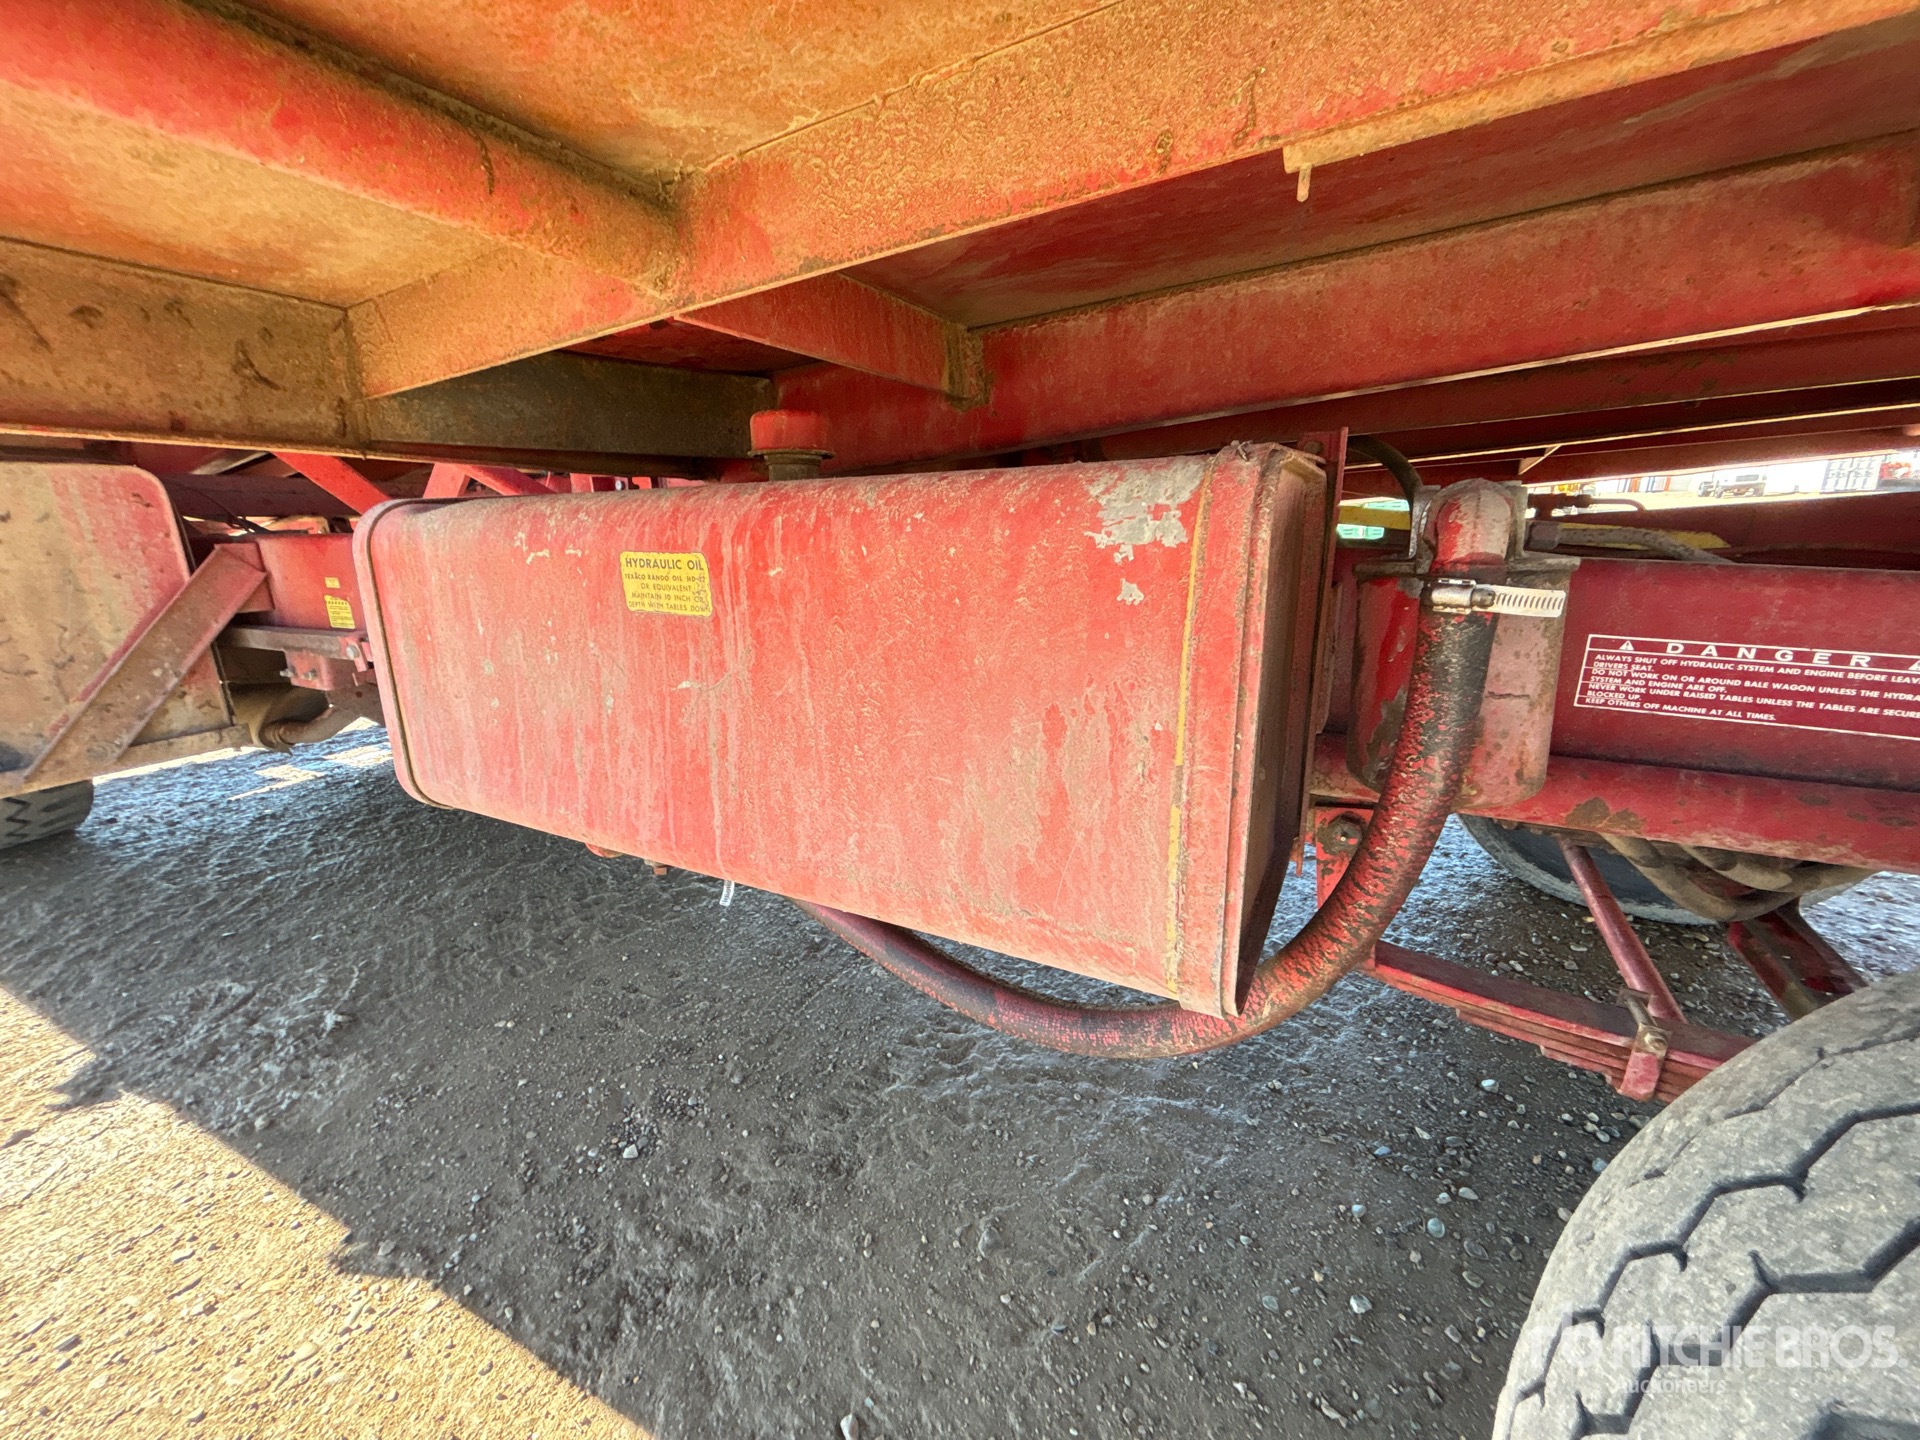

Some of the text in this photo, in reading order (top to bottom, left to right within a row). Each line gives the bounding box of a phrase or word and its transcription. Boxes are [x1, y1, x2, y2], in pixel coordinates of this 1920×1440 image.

[625, 558, 704, 571] HYDRAULIC OIL
[632, 592, 662, 600] MAINTAIN
[674, 594, 690, 602] INCH
[666, 603, 687, 611] TABLES
[1666, 643, 1871, 668] DANGER
[1595, 654, 1631, 662] ALWAYS
[1680, 660, 1734, 670] HYDRAULIC
[1737, 663, 1774, 674] SYSTEM
[1777, 667, 1801, 675] AND
[1804, 669, 1844, 678] ENGINE
[1847, 673, 1888, 682] BEFORE
[1590, 676, 1622, 684] SYSTEM
[1649, 681, 1683, 689] ENGINE
[1631, 672, 1659, 680] WORK
[1697, 677, 1741, 686] AROUND
[1772, 683, 1815, 692] WAGON
[1818, 687, 1856, 696] UNLESS
[1860, 690, 1880, 698] THE
[1587, 691, 1625, 699] BLOCKED
[1588, 683, 1616, 691] NEVER
[1619, 686, 1646, 694] WORK
[1650, 688, 1680, 697] UNDER
[1683, 691, 1716, 700] RAISED
[1720, 694, 1753, 703] TABLES
[1756, 697, 1793, 707] UNLESS
[1796, 701, 1815, 709] THE
[1819, 703, 1856, 712] TABLES
[1858, 707, 1880, 715] ARE
[1607, 700, 1641, 708] OTHERS
[1662, 704, 1707, 714] MACHINE
[1725, 710, 1742, 718] ALL
[1746, 712, 1776, 721] TIMES.
